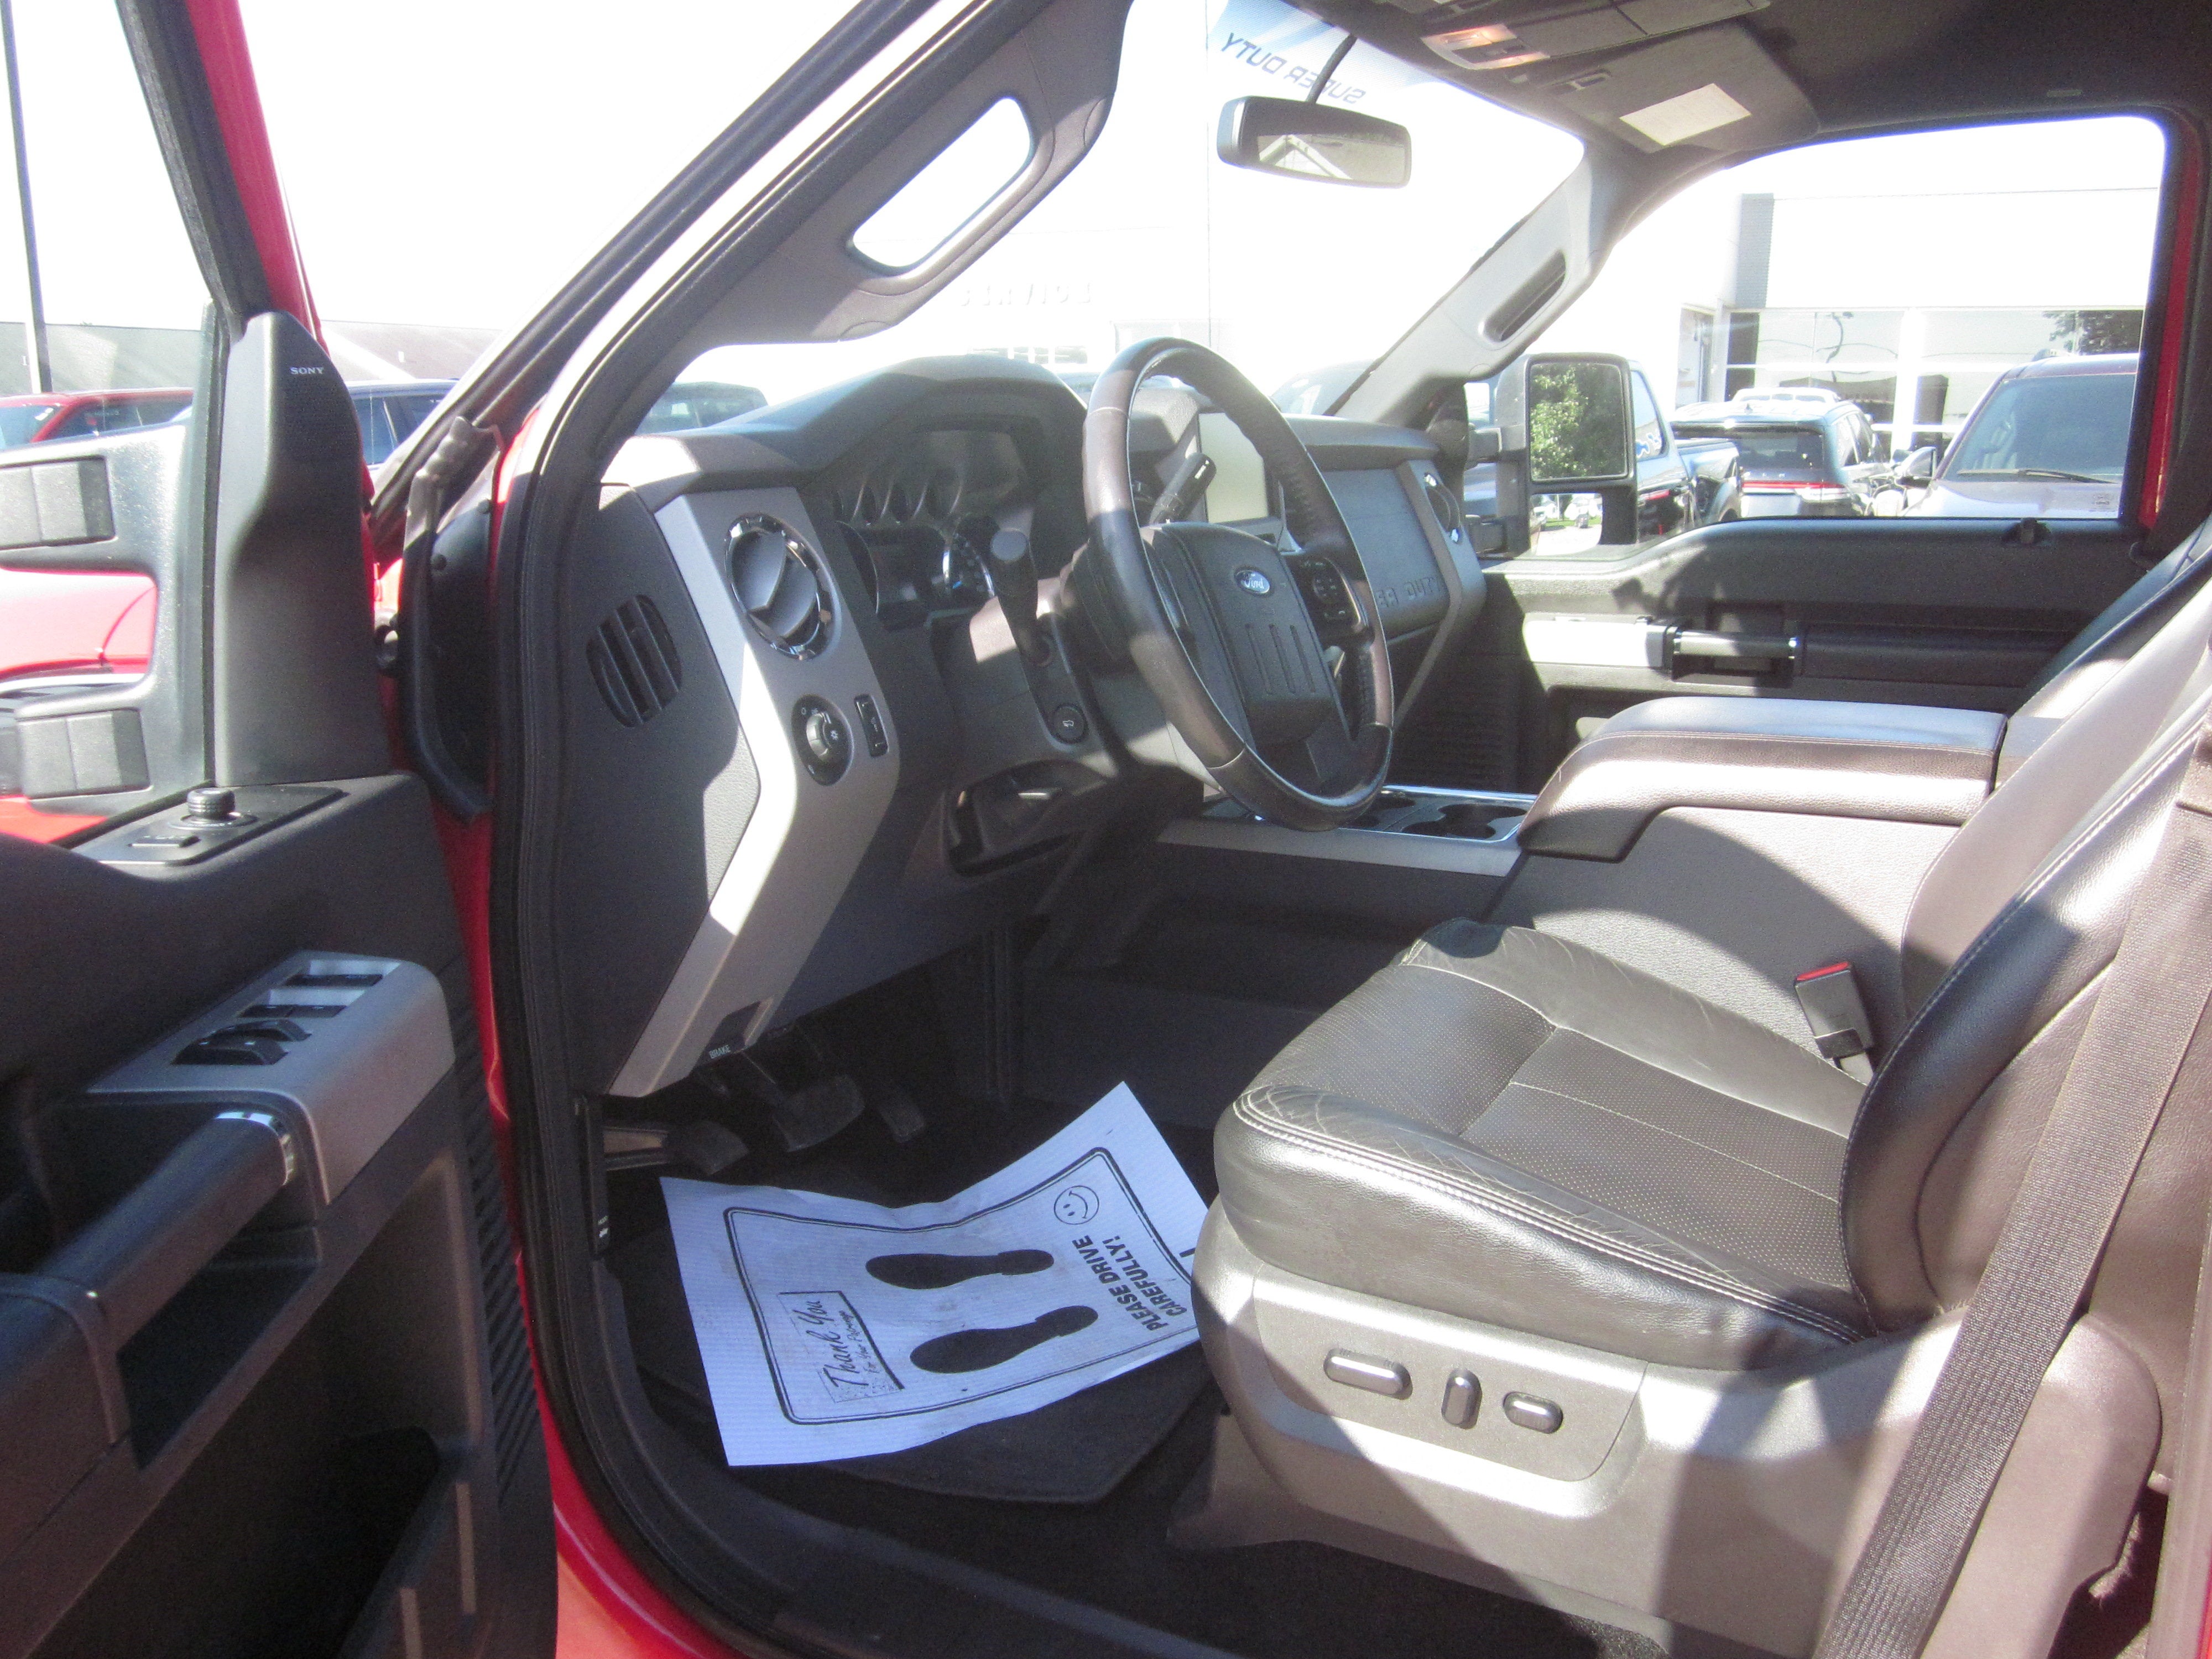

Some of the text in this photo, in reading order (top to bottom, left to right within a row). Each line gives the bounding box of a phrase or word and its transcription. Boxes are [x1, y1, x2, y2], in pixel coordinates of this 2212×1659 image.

[289, 366, 325, 375] SONY
[1242, 572, 1265, 589] Ford
[1071, 1234, 1168, 1332] PLEASE DRIVE
[1102, 1234, 1188, 1317] CAREFULLY!
[792, 1300, 869, 1387] Thank You
